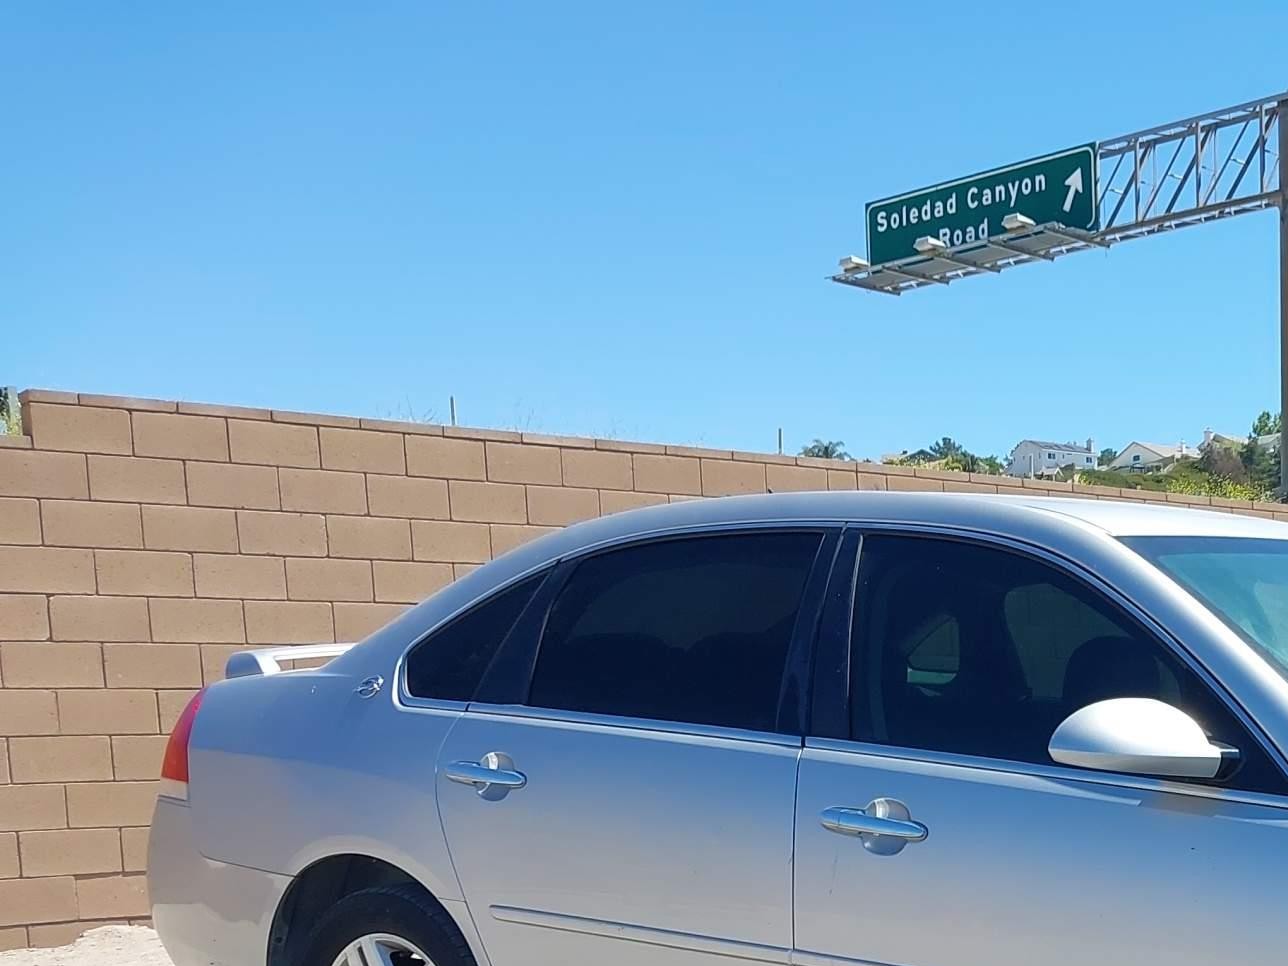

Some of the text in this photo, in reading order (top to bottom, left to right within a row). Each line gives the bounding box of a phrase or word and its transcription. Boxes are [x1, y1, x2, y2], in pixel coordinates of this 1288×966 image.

[876, 173, 1046, 232] Soledad Canyon
[938, 217, 988, 248] Road
